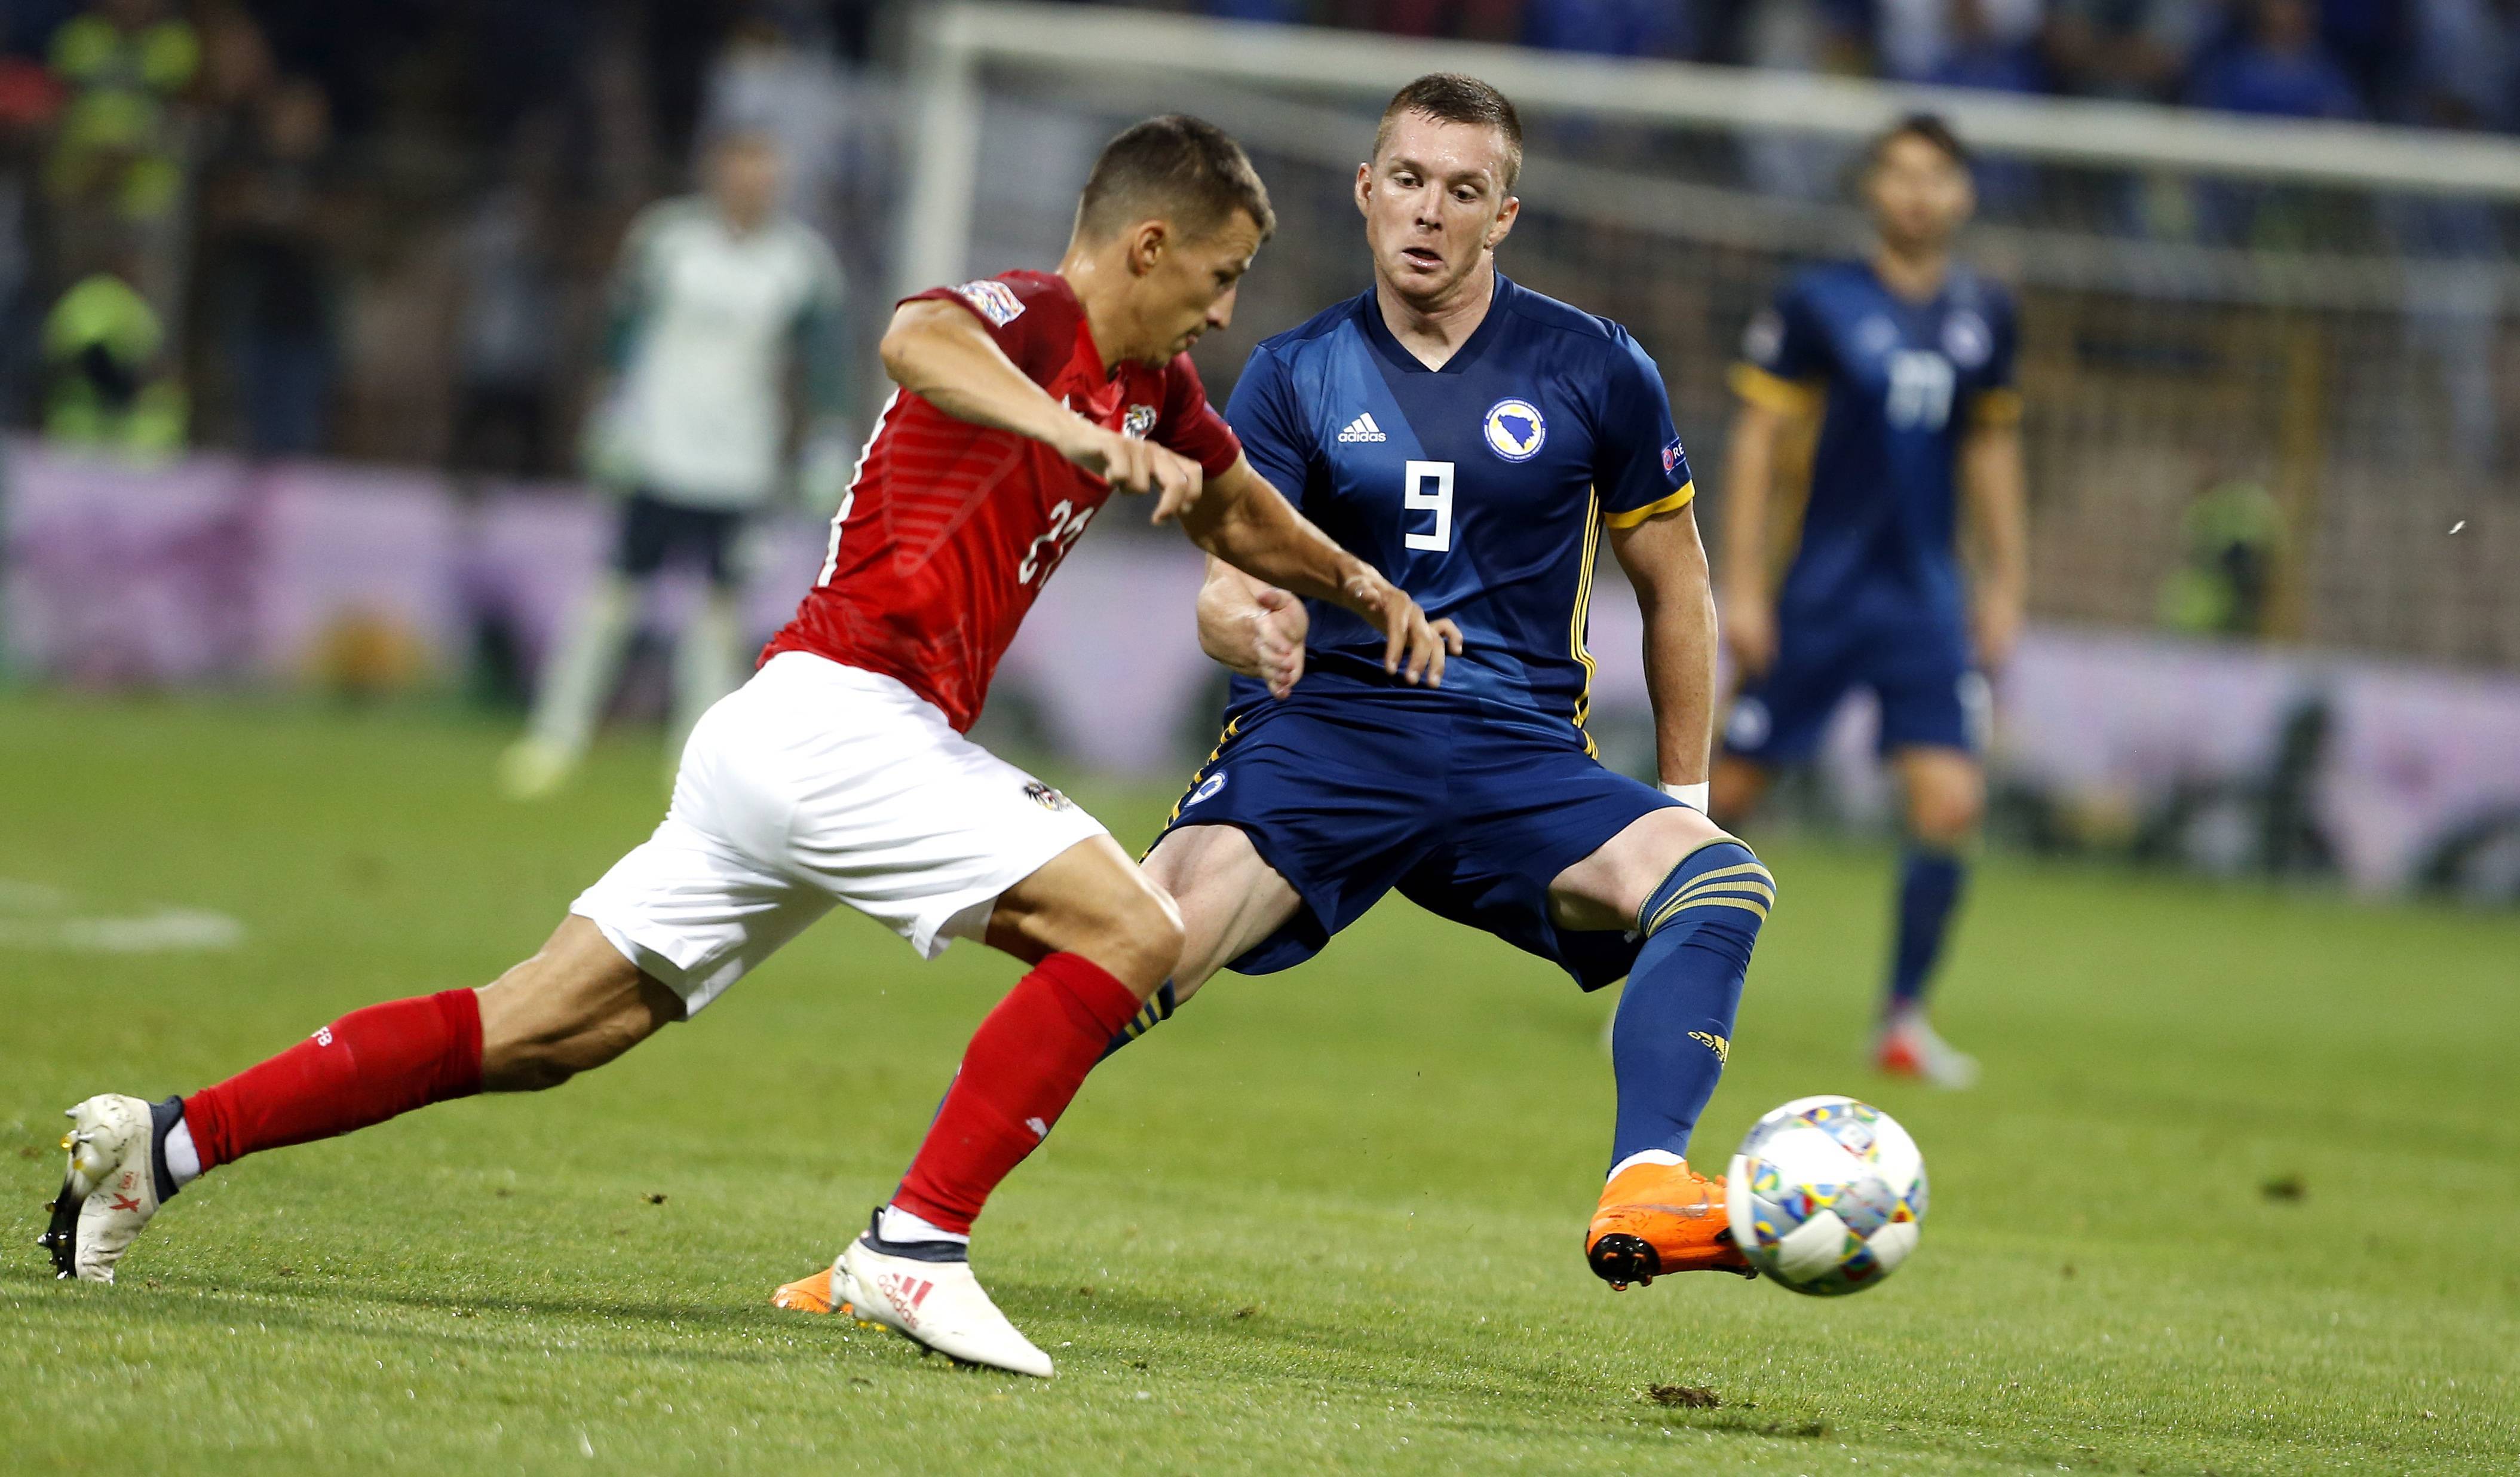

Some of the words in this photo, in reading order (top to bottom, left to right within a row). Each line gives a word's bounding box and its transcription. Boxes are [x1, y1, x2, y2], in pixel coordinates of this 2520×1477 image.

[1338, 431, 1387, 442] adidas
[1405, 461, 1455, 552] 9
[878, 1274, 919, 1329] adidas
